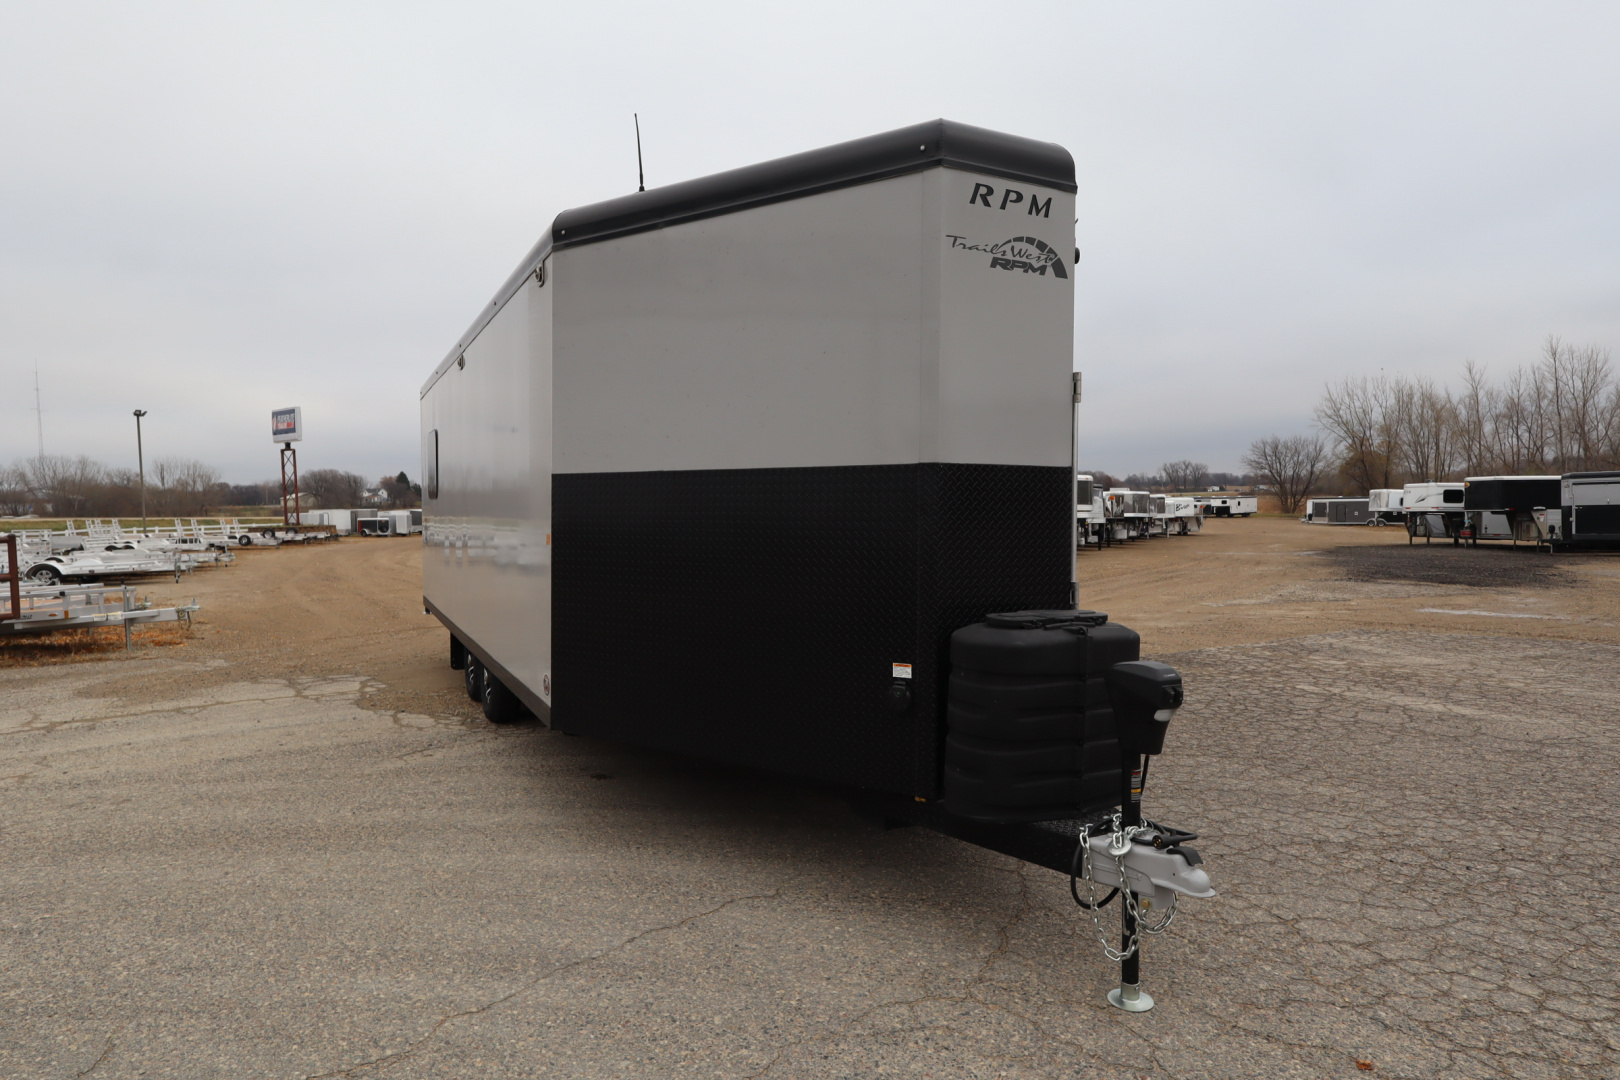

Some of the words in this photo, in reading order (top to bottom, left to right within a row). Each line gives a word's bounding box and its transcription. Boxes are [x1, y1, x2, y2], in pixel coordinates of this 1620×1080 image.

[969, 182, 1052, 218] RPM
[945, 234, 1008, 257] Trails
[1010, 244, 1053, 264] West
[990, 256, 1048, 276] RPM
